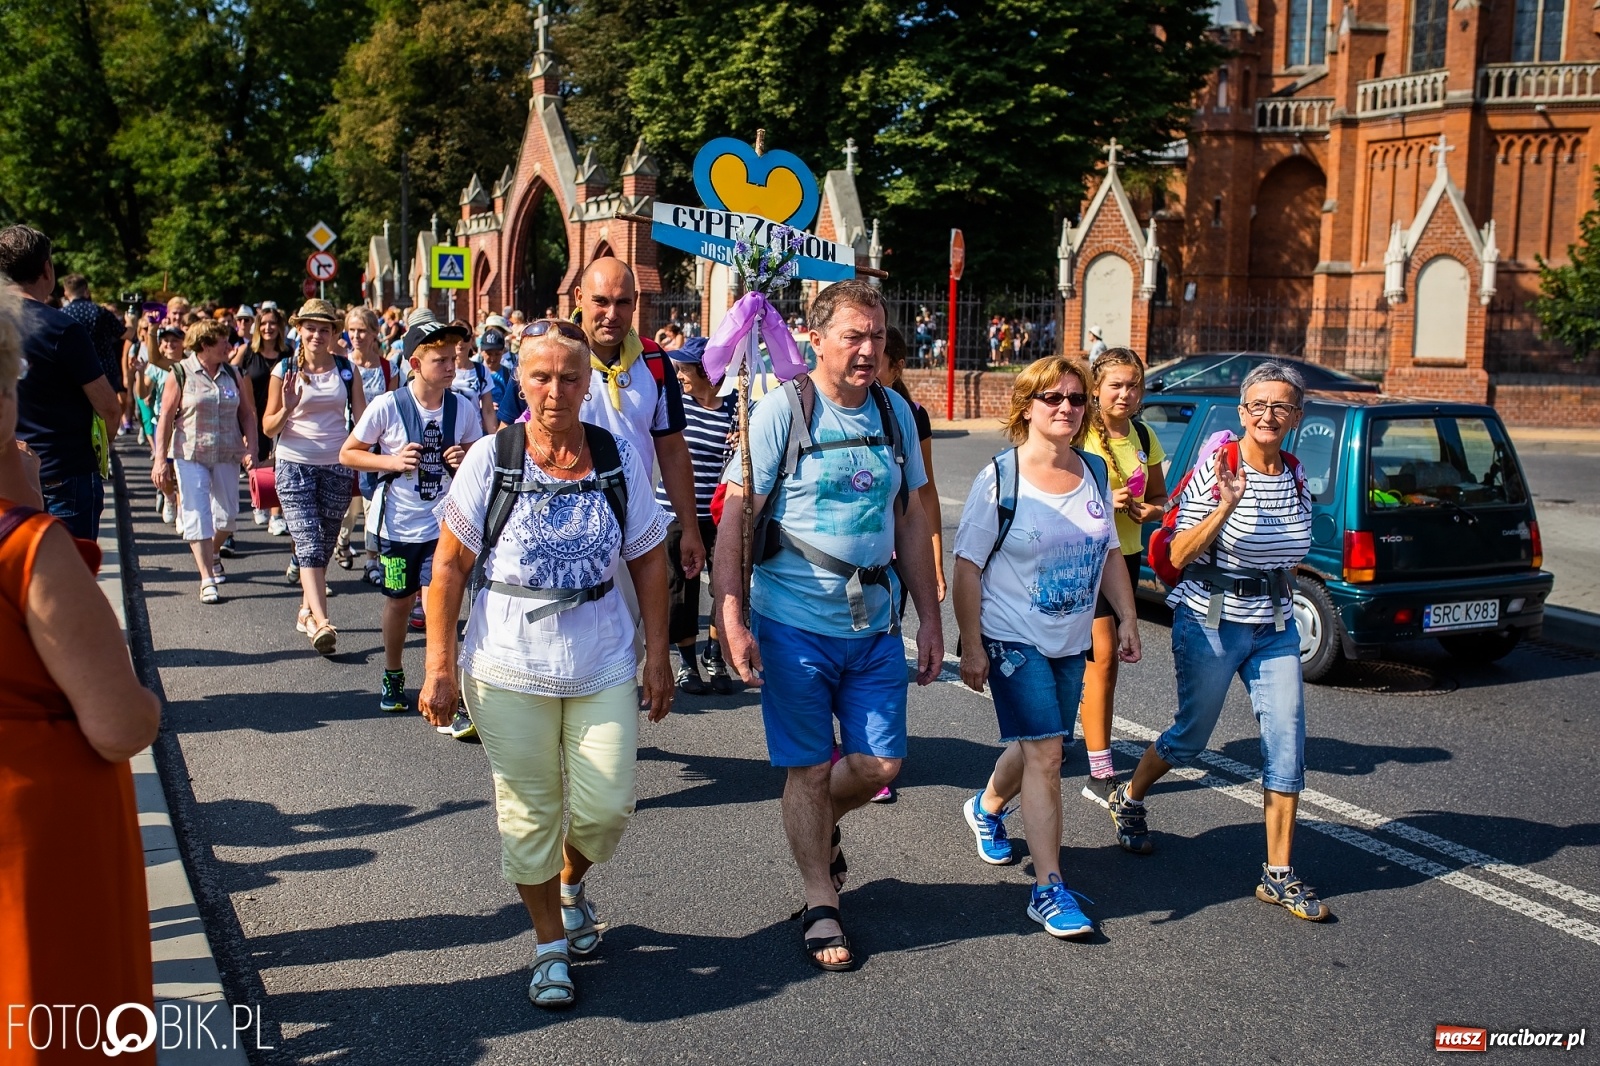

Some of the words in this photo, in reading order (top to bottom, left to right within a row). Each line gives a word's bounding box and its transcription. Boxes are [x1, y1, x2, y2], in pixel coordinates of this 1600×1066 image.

[700, 240, 737, 267] JASN
[385, 566, 402, 580] UP
[1433, 605, 1461, 624] SRC
[1465, 601, 1497, 621] K983
